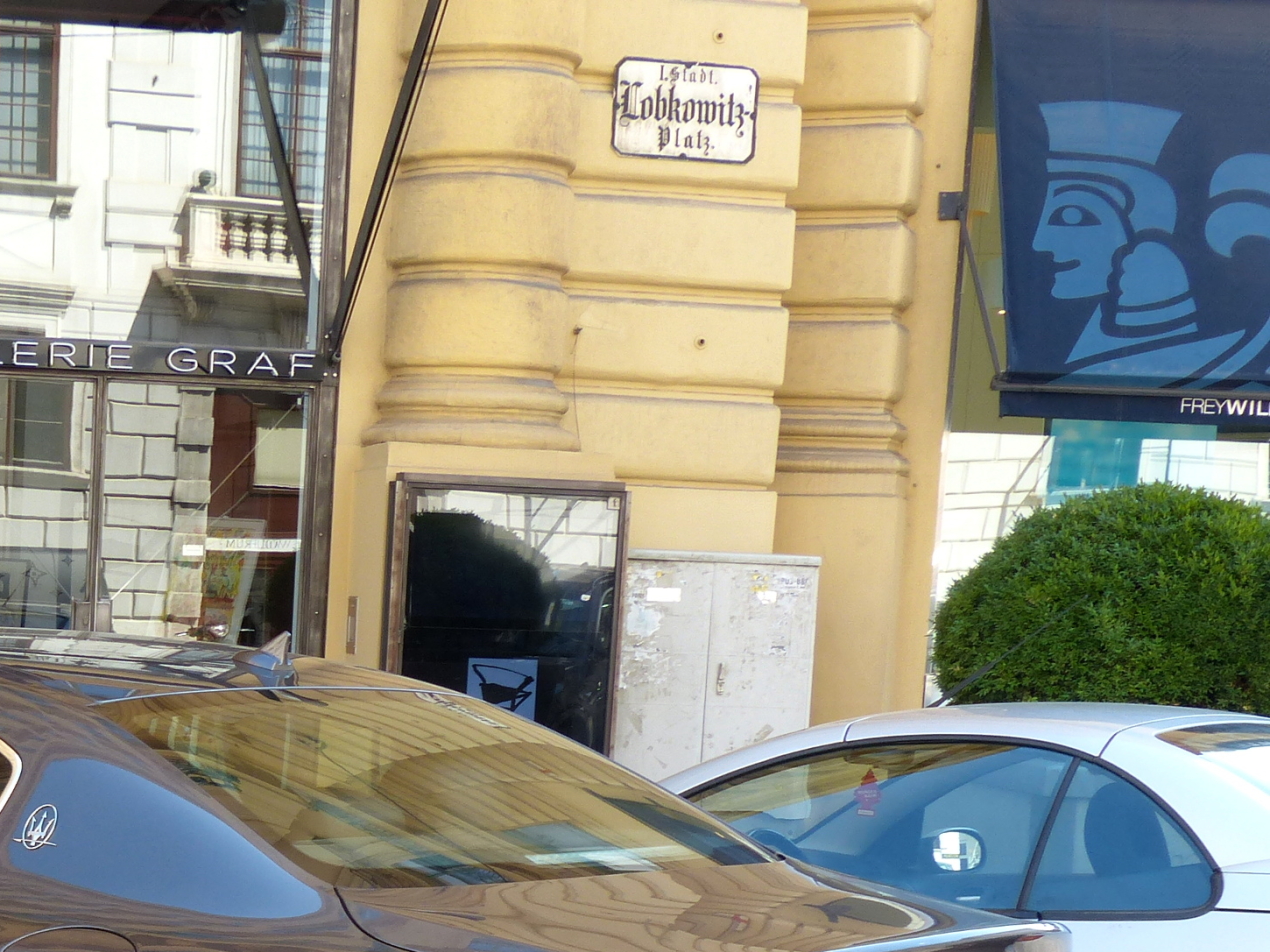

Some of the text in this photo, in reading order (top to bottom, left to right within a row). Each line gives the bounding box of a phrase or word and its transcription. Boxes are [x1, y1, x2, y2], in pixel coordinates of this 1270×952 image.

[619, 80, 750, 138] Lobkowitz-
[657, 125, 715, 156] Platz.
[166, 347, 317, 377] GRAF
[1180, 397, 1270, 417] FREYWIL
